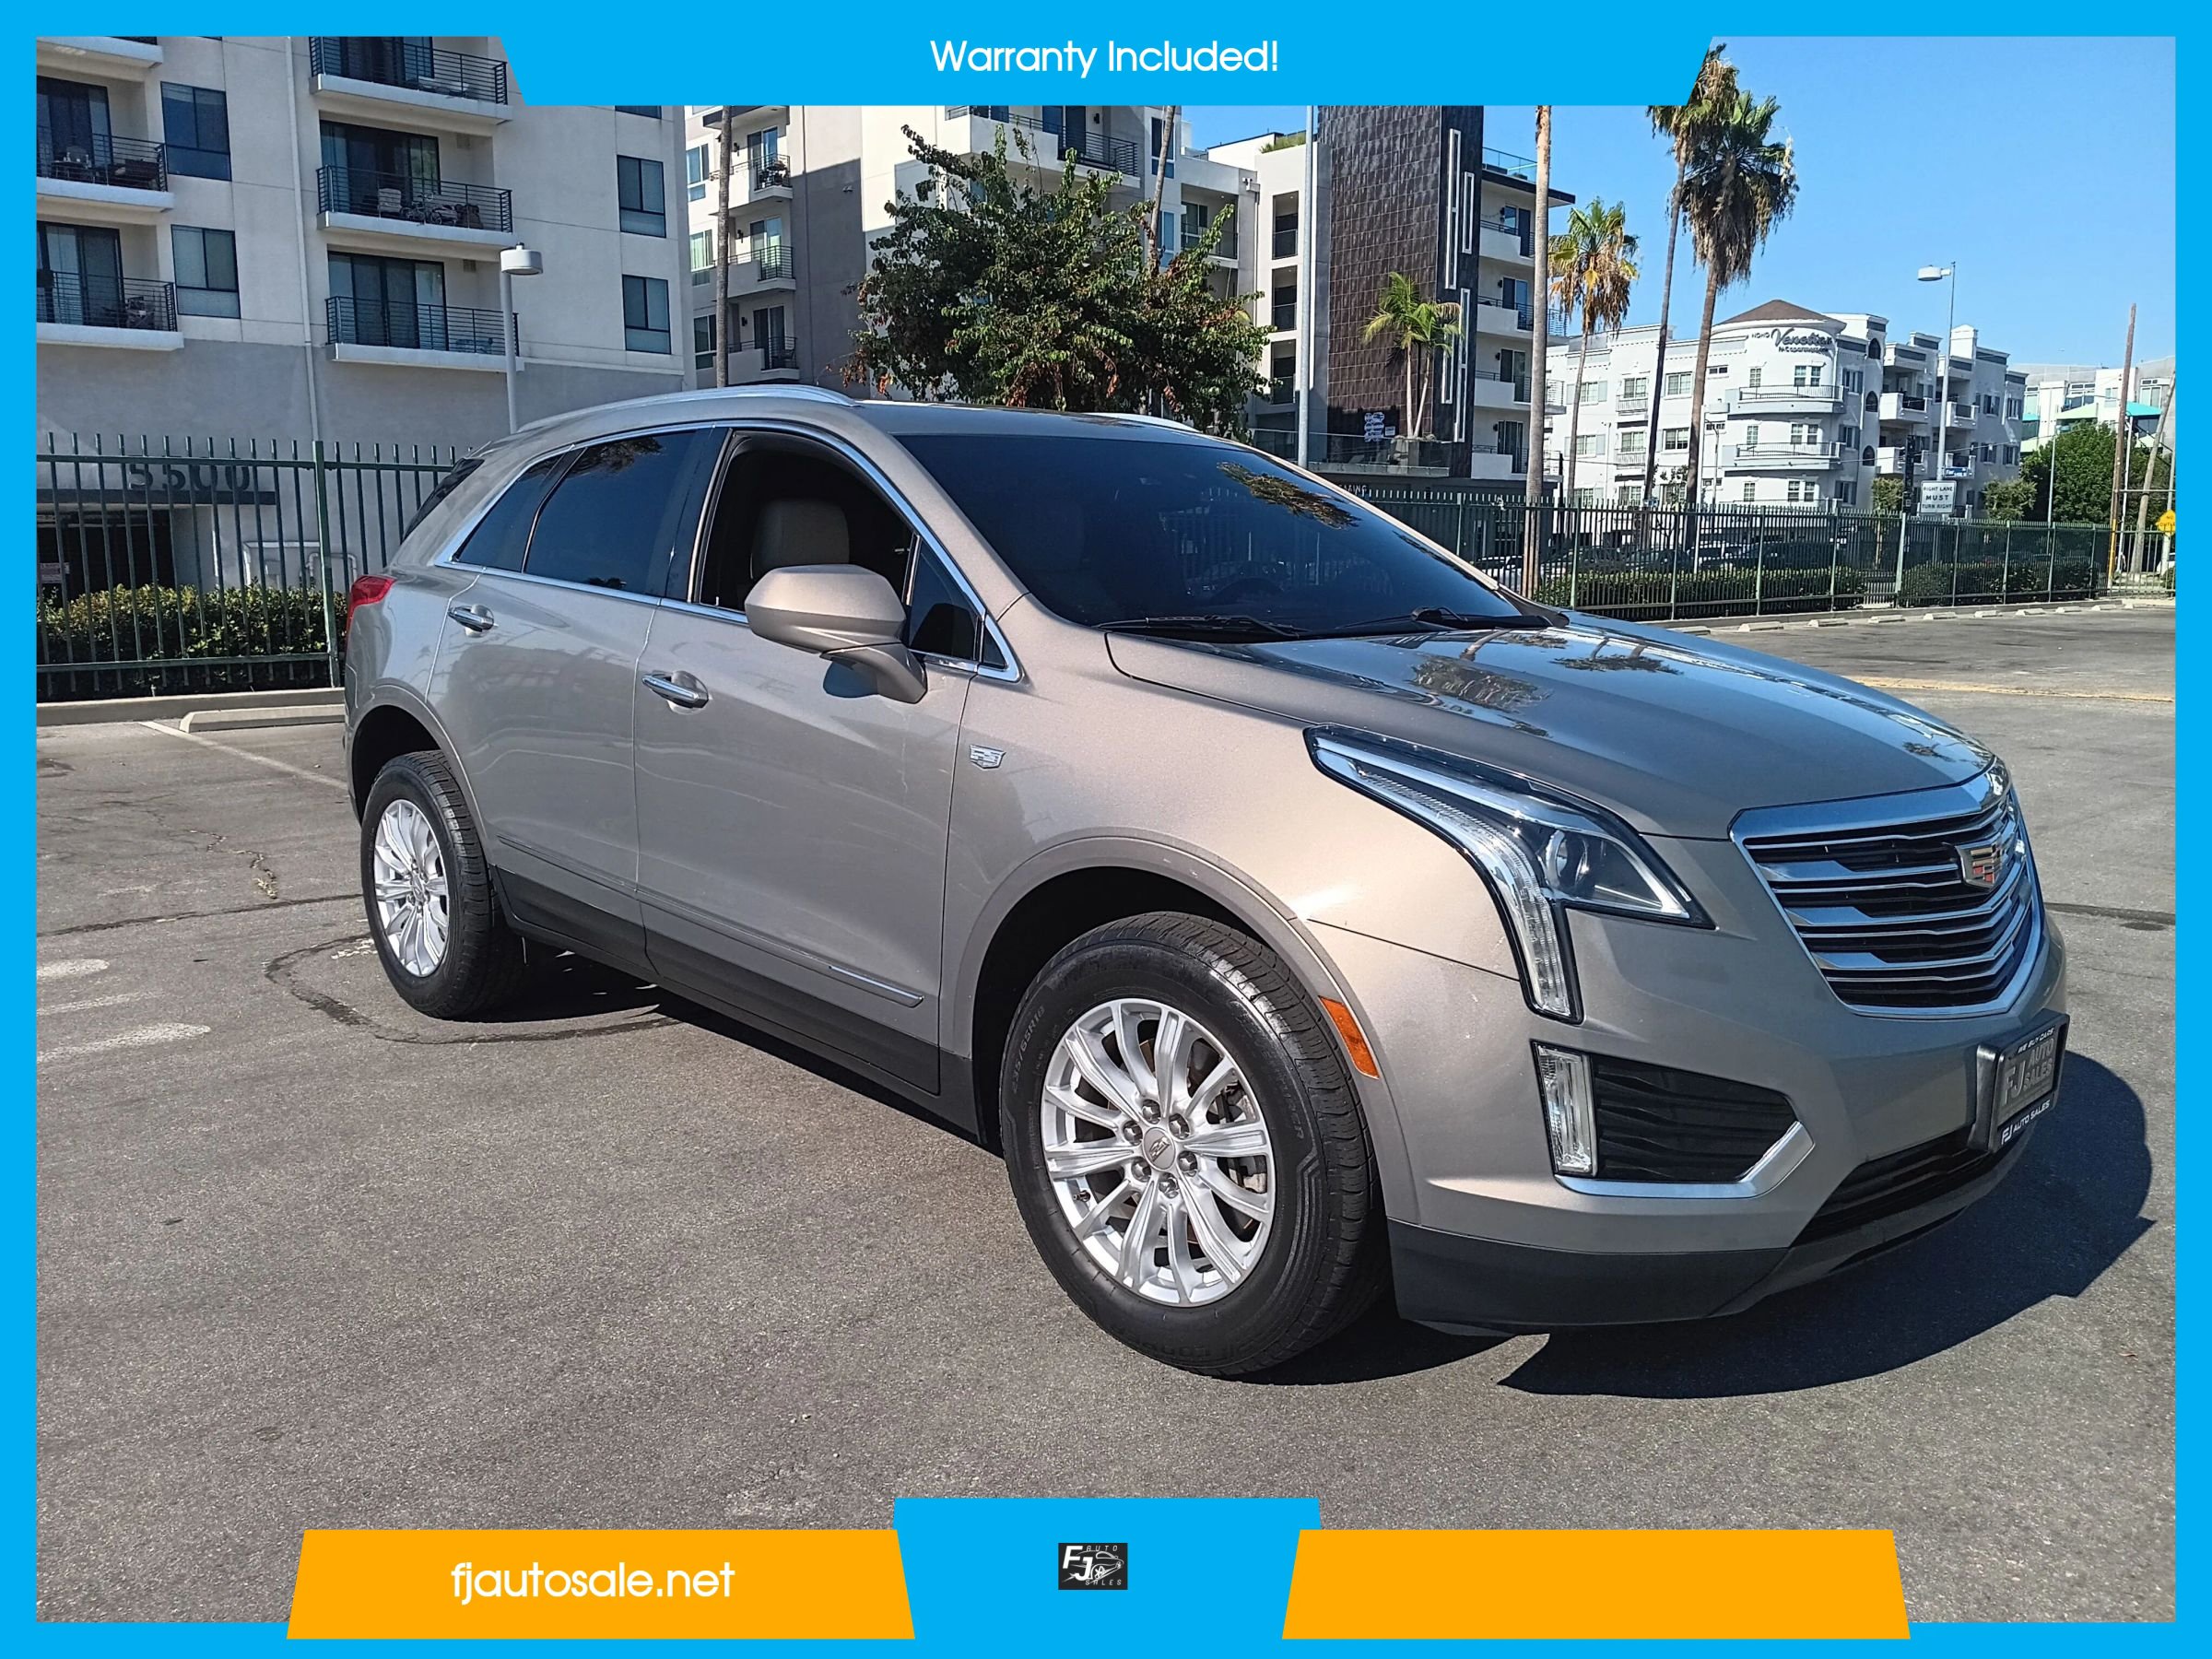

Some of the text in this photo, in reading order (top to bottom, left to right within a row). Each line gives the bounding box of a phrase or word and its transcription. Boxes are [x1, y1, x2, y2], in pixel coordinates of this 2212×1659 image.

[1771, 327, 1832, 347] Venetian
[129, 455, 251, 491] 5500
[2028, 1038, 2054, 1066] AUTO
[2005, 1060, 2026, 1105] FJ
[2023, 1058, 2053, 1091] SALES
[2001, 1099, 2051, 1146] FJ AUTO SALES
